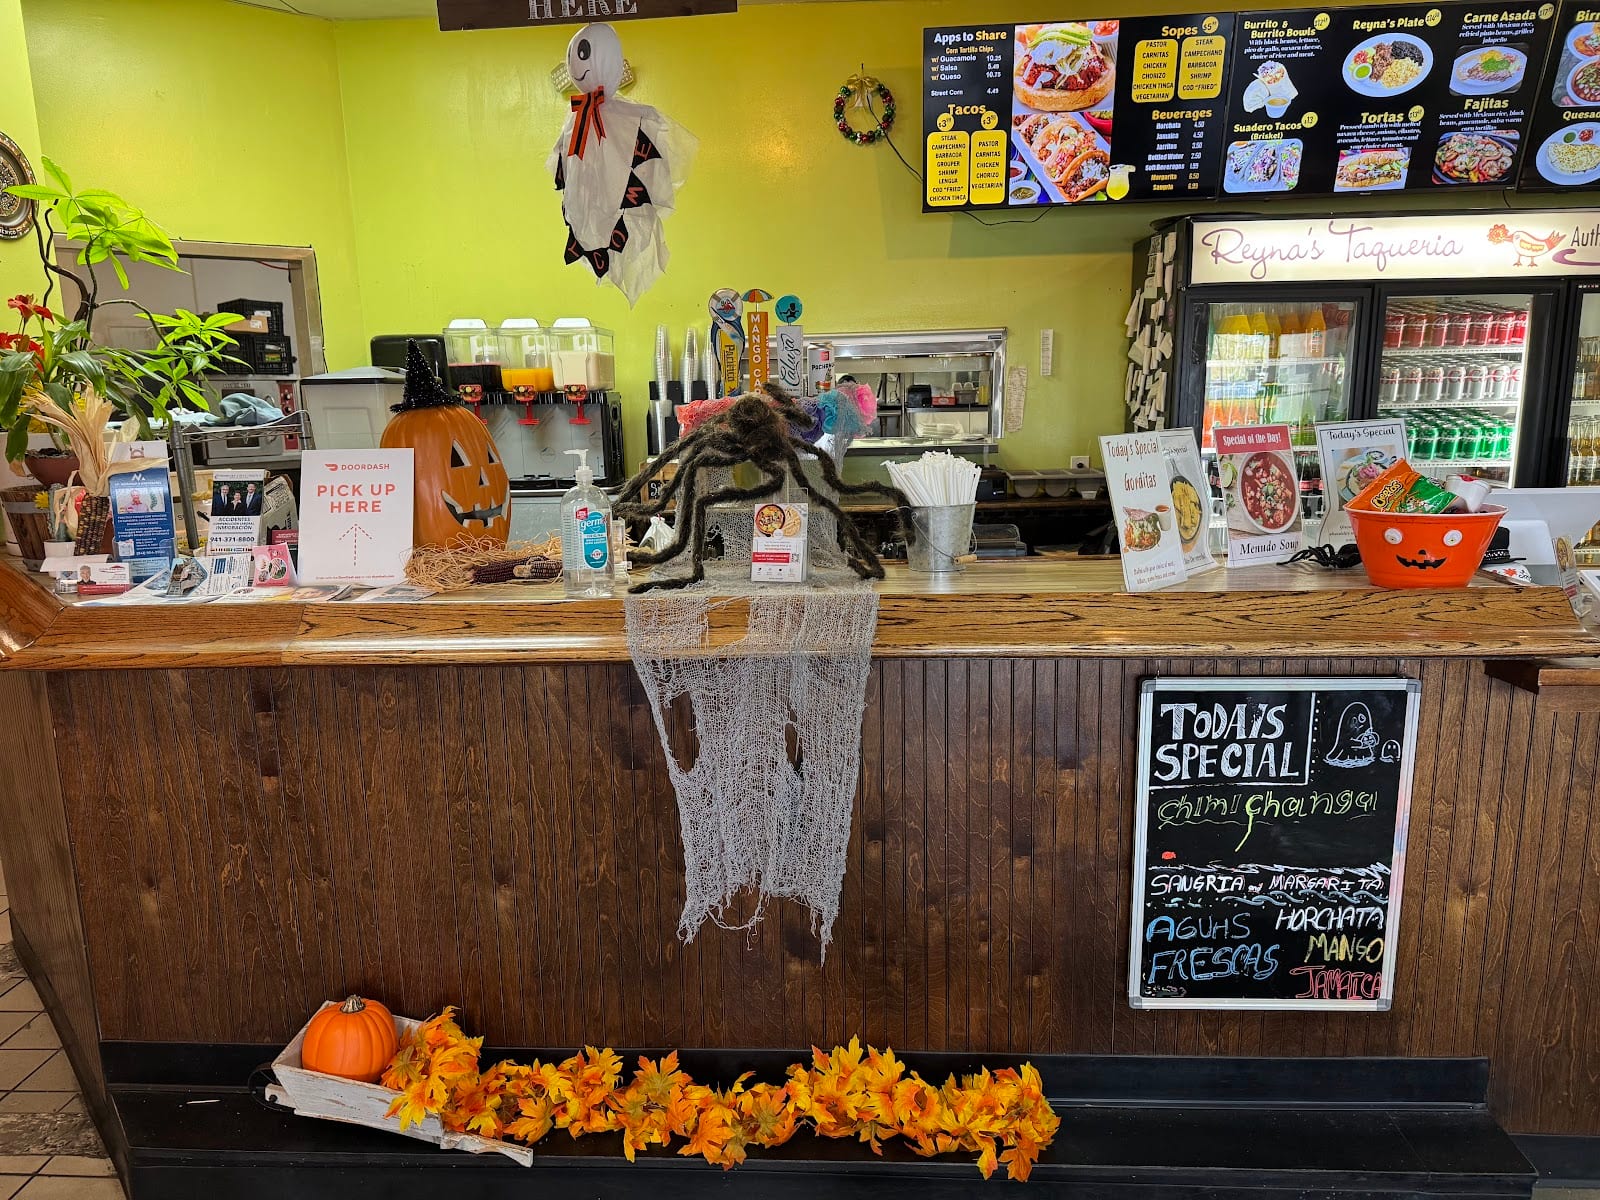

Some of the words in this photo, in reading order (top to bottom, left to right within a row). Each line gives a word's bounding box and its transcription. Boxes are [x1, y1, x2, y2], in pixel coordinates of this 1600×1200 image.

[1464, 12, 1499, 23] Carne
[1500, 10, 1536, 21] Asada
[1244, 19, 1278, 29] Burrito
[1282, 20, 1288, 28] &
[1353, 18, 1395, 32] Reyna's
[1396, 17, 1424, 28] Plate
[934, 32, 961, 45] Apps
[963, 31, 974, 41] to
[975, 30, 1007, 41] Share
[1161, 25, 1198, 39] Sopes
[1251, 29, 1285, 38] Burrito
[1286, 27, 1316, 37] Bowls
[1195, 38, 1213, 46] STEAK
[940, 54, 976, 62] Guacamole
[1142, 51, 1169, 59] CARNITAS
[1184, 49, 1223, 57] CAMPECHANO
[948, 103, 986, 116] Tacos
[1464, 97, 1509, 113] Fajitas
[1152, 109, 1213, 121] Beverages
[1361, 111, 1404, 124] Tortas
[1233, 122, 1273, 133] Suadero
[1275, 121, 1302, 131] Tacos
[1250, 131, 1283, 140] (Brisket)
[975, 150, 1001, 158] CARNITAS
[971, 182, 1003, 190] VEGETARIAN
[1201, 226, 1324, 280] Reyna's
[1328, 220, 1464, 272] Taqueria
[750, 313, 761, 364] MANGO
[1222, 434, 1247, 447] Special
[1247, 433, 1254, 444] of
[1255, 432, 1266, 443] the
[1266, 431, 1282, 445] Day!
[1326, 430, 1361, 442] Today's
[1362, 426, 1396, 439] Special
[1106, 438, 1133, 462] Today's
[1134, 436, 1159, 460] Special
[341, 463, 390, 471] DOORDASH
[1124, 472, 1157, 492] Gorditas
[317, 484, 363, 497] PICK
[370, 483, 396, 496] UP
[330, 500, 382, 513] HERE
[1239, 540, 1277, 555] Menudo
[1280, 538, 1299, 552] Soup
[1153, 742, 1299, 781] SPECIAL
[1150, 874, 1245, 896] SANGRIA
[1248, 883, 1263, 893] and
[1268, 873, 1384, 892] MARGARITA
[1275, 905, 1384, 932] HORCHATA
[1304, 932, 1384, 964] MANGO
[1148, 943, 1280, 984] FRESCAS
[1289, 965, 1382, 1000] JAMAICA
